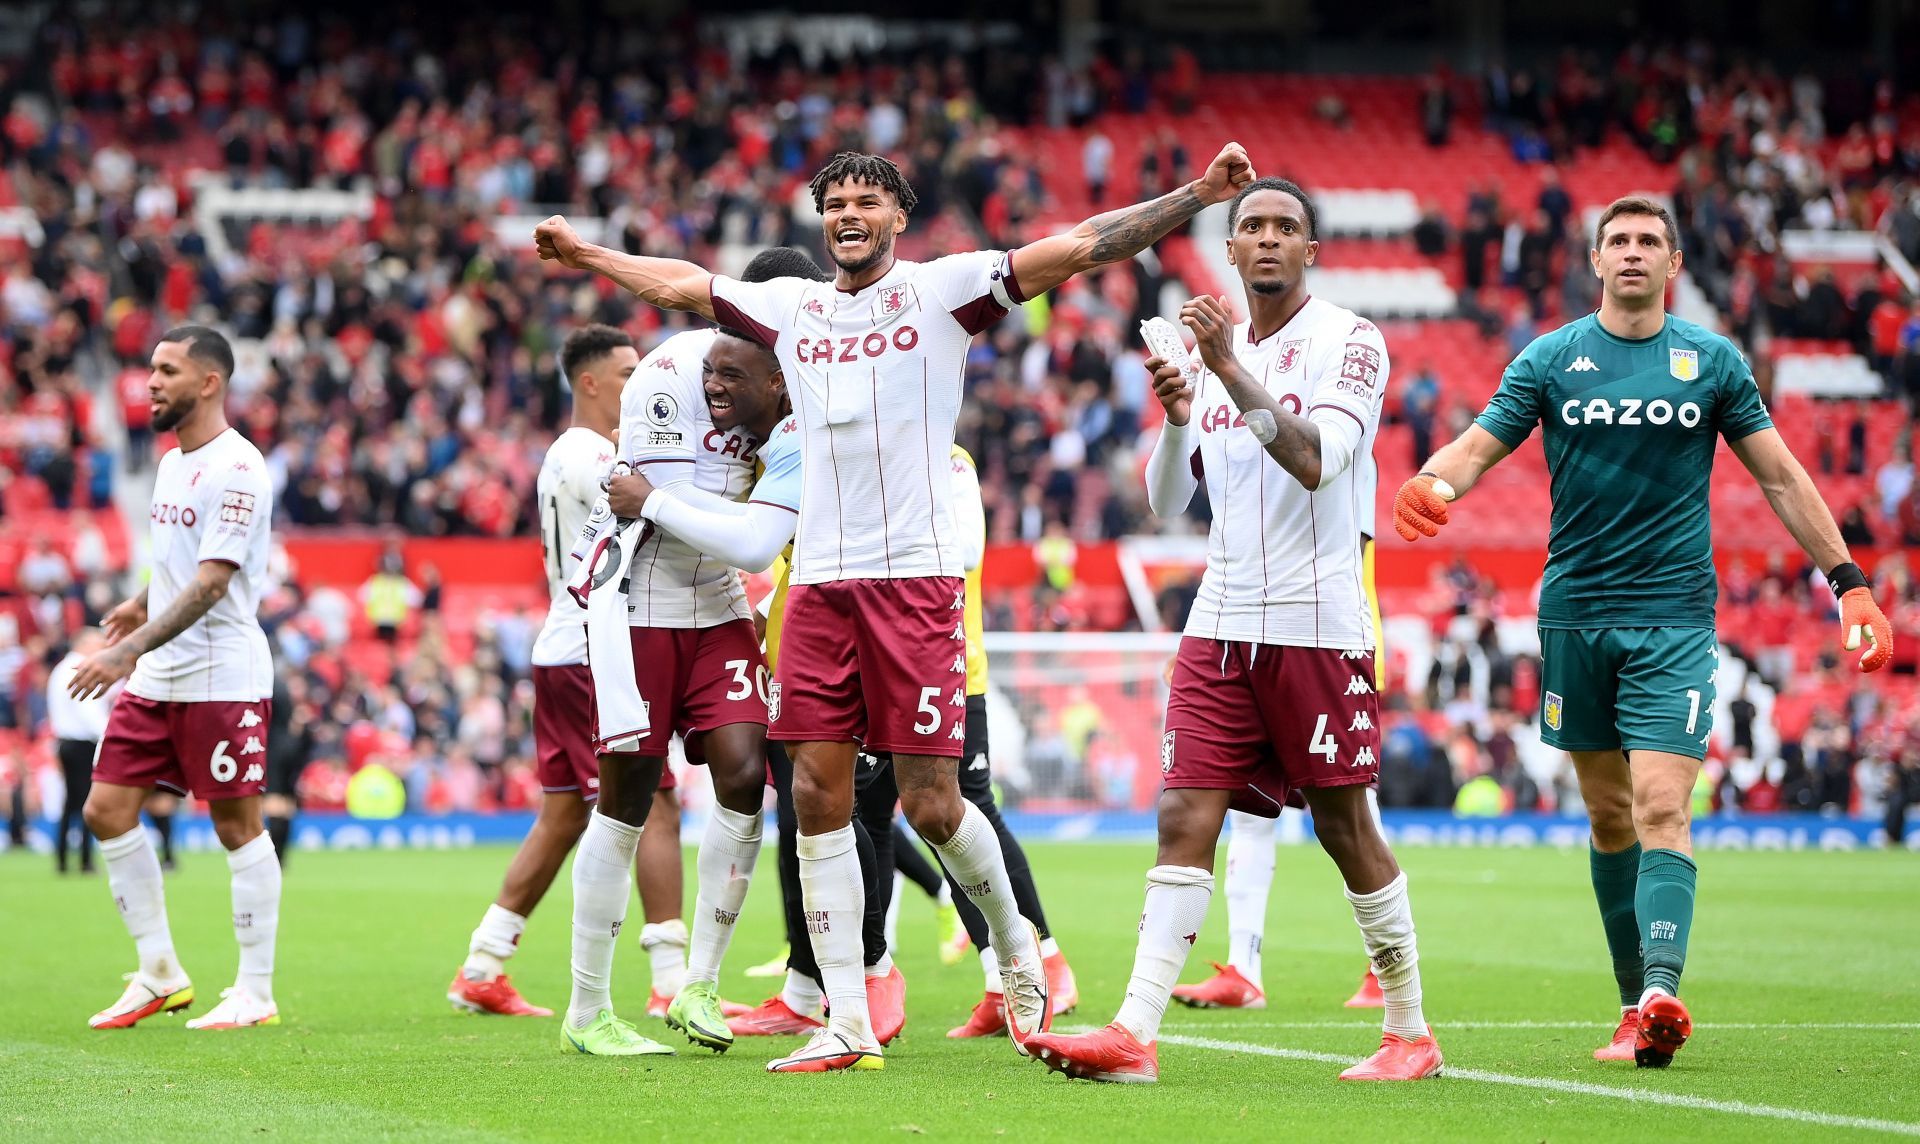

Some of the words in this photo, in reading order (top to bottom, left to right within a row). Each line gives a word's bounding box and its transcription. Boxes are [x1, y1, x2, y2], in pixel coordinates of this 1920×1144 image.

[797, 325, 919, 365] CAZOO
[1672, 350, 1696, 359] AVFC
[1201, 393, 1302, 434] CAO
[1561, 398, 1701, 428] CAZOO
[725, 659, 770, 707] 30
[914, 686, 942, 735] 5
[1686, 690, 1700, 735] 1
[1308, 714, 1339, 764] 4
[210, 740, 238, 783] 6
